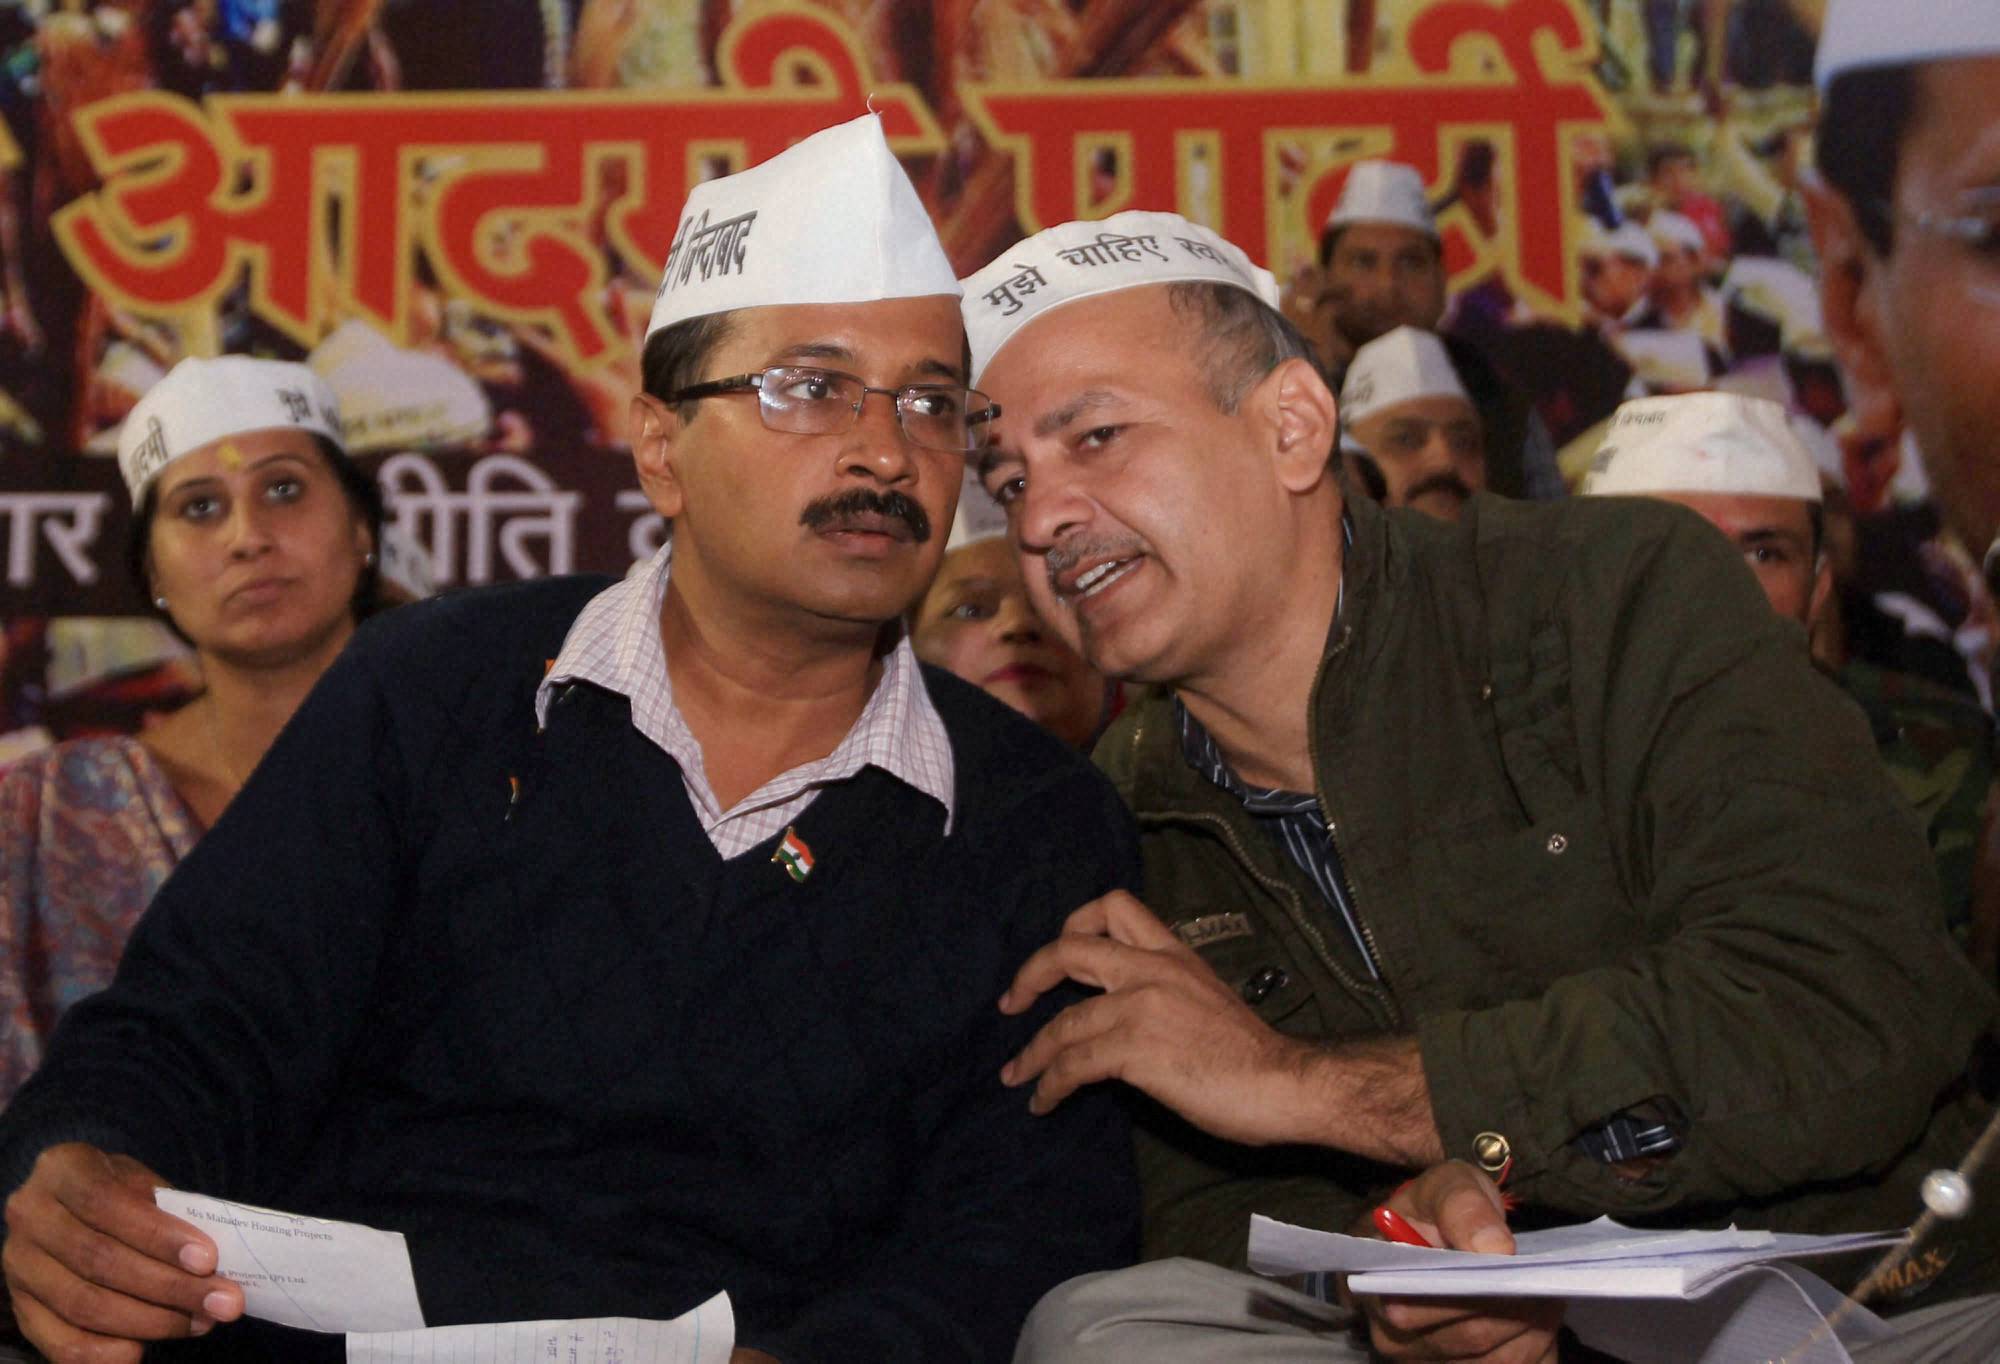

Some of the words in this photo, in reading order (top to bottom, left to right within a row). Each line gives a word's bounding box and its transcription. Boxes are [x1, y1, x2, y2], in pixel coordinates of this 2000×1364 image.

[982, 263, 1047, 316] मुझे
[1056, 232, 1170, 267] चाहिए
[252, 1220, 292, 1237] Housing
[294, 1227, 334, 1241] Projects
